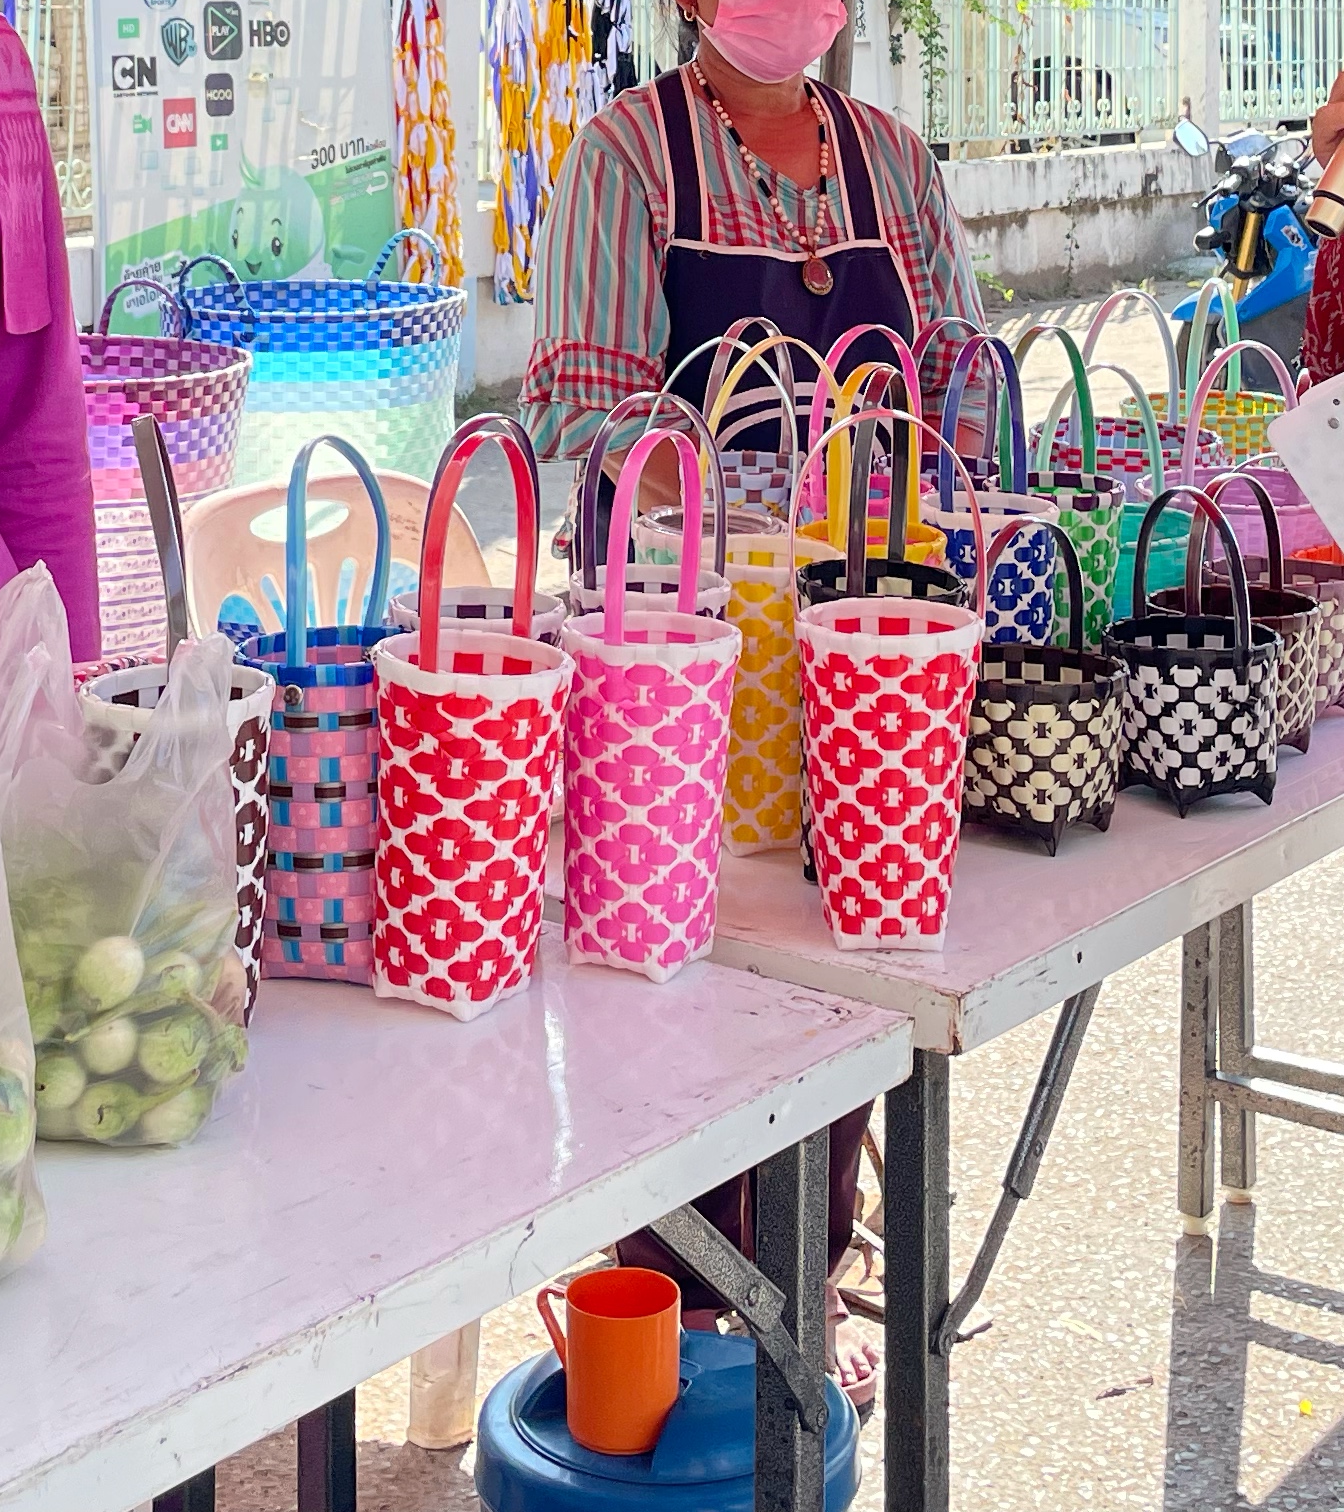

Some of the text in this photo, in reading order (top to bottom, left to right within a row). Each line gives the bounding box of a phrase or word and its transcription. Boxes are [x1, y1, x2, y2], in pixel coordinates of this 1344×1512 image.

[122, 24, 135, 33] HD
[211, 25, 231, 36] PLAY
[249, 20, 291, 47] HBO
[112, 55, 157, 91] CN
[206, 89, 232, 100] HOOQ
[166, 112, 193, 133] CNN
[311, 144, 336, 169] 300
[340, 137, 365, 159] บาท
